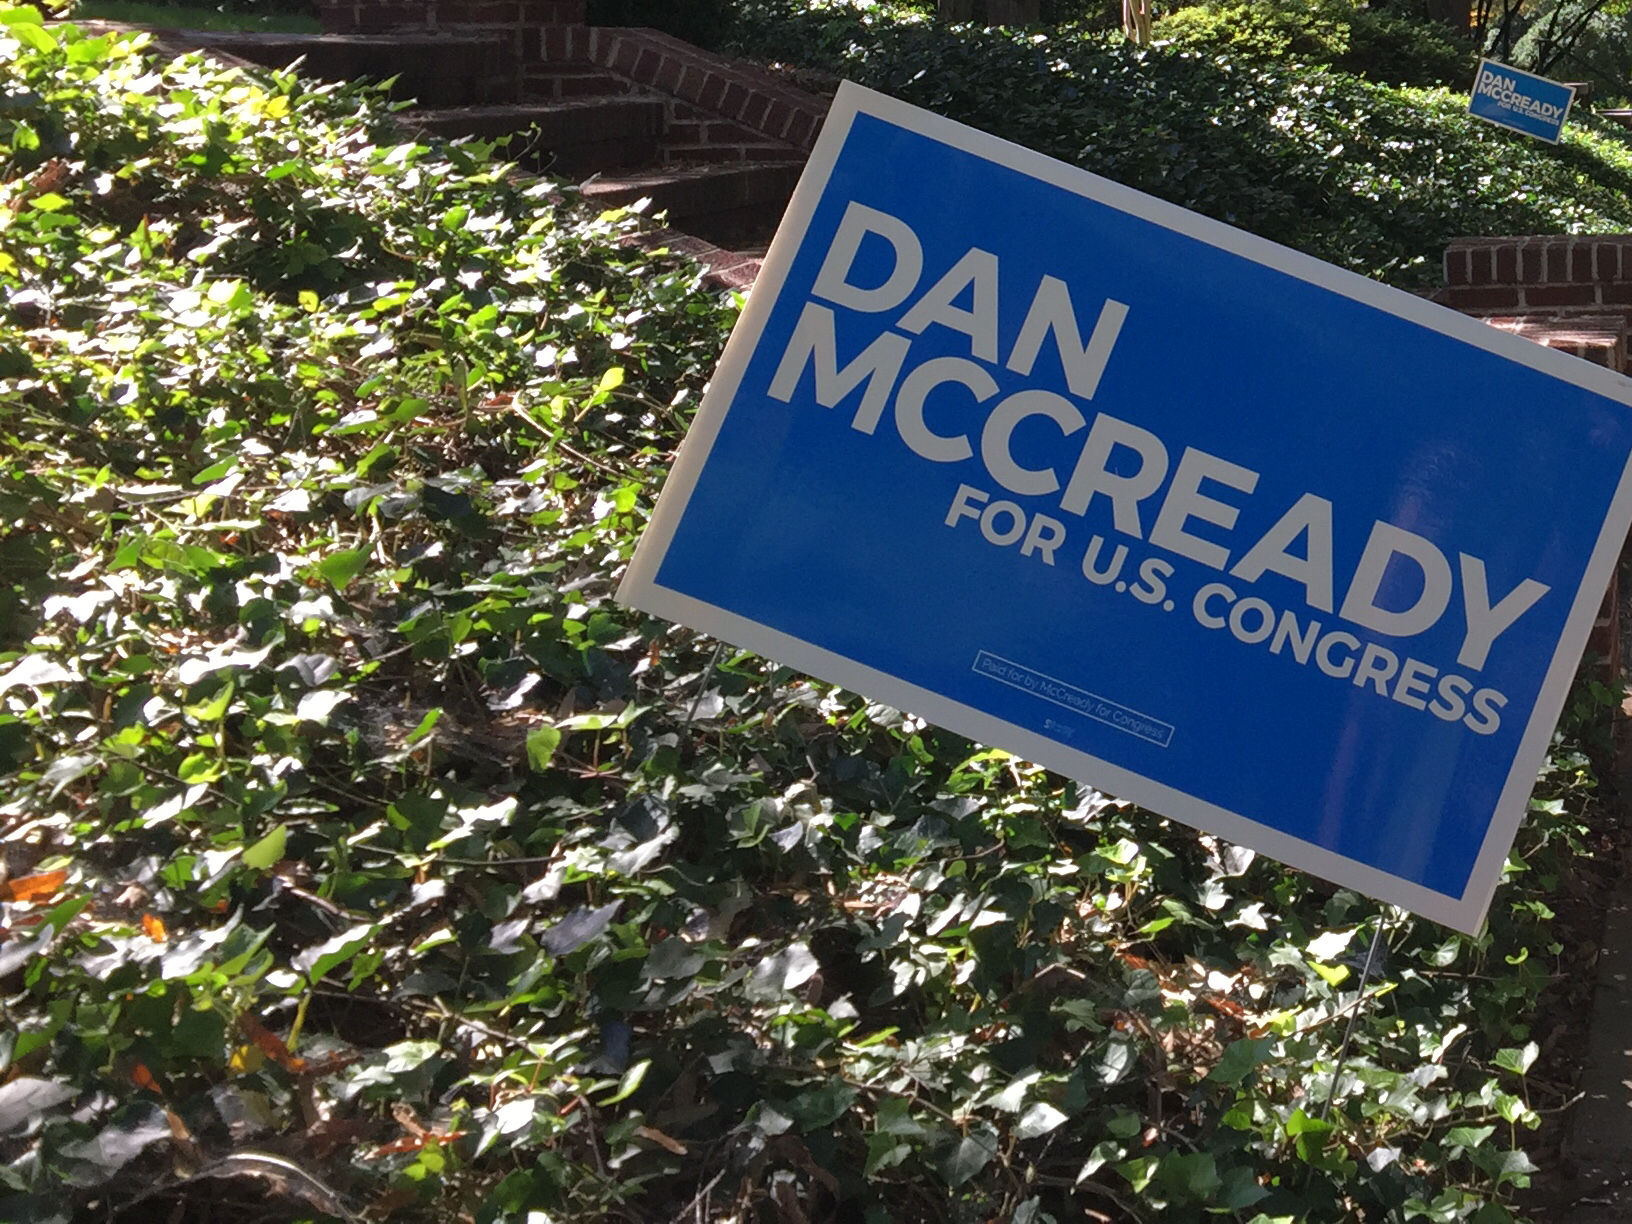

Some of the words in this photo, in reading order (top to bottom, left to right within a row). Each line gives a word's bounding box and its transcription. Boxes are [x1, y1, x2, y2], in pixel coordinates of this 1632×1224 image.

[1477, 82, 1563, 119] MCCREADY
[1481, 70, 1516, 92] DAN
[812, 201, 1129, 401] DAN
[768, 302, 1550, 671] MCCREADY
[945, 484, 1065, 565] FOR
[1083, 536, 1175, 611] U.S.
[1194, 584, 1508, 734] CONGRESS
[982, 658, 1006, 677] Paid
[1008, 669, 1023, 682] for
[1024, 674, 1040, 690] by
[1039, 681, 1095, 712] McCready
[1095, 699, 1111, 717] for
[1112, 710, 1164, 739] Congress
